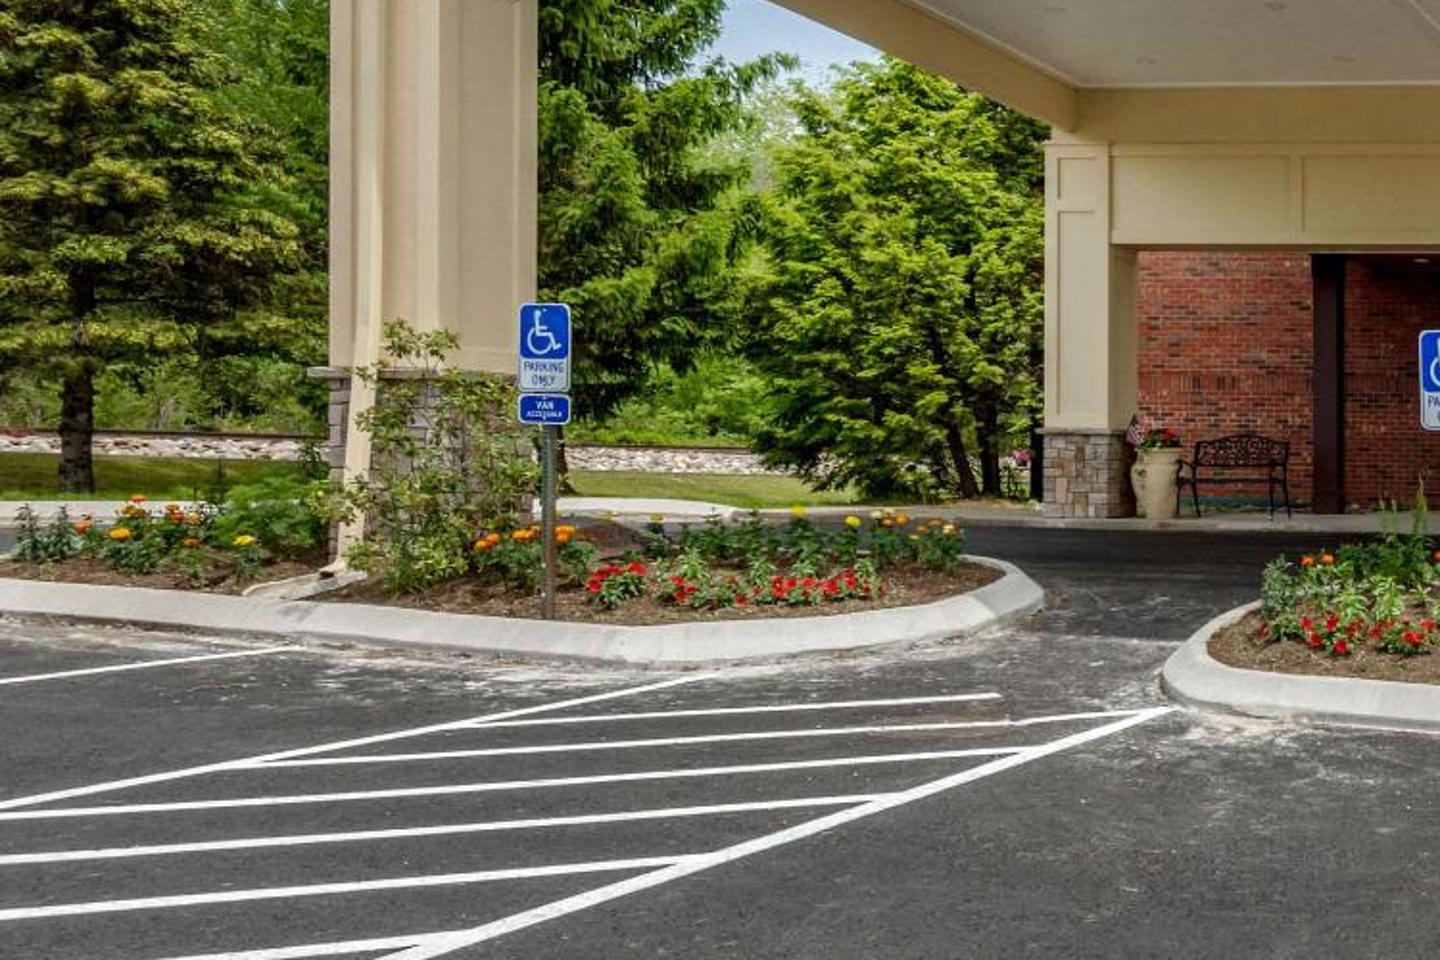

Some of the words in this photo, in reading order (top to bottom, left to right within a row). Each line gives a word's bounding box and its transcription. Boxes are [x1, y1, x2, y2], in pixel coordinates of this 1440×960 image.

[523, 361, 564, 373] PARKING
[531, 374, 556, 386] ONLY
[535, 400, 555, 410] VAN
